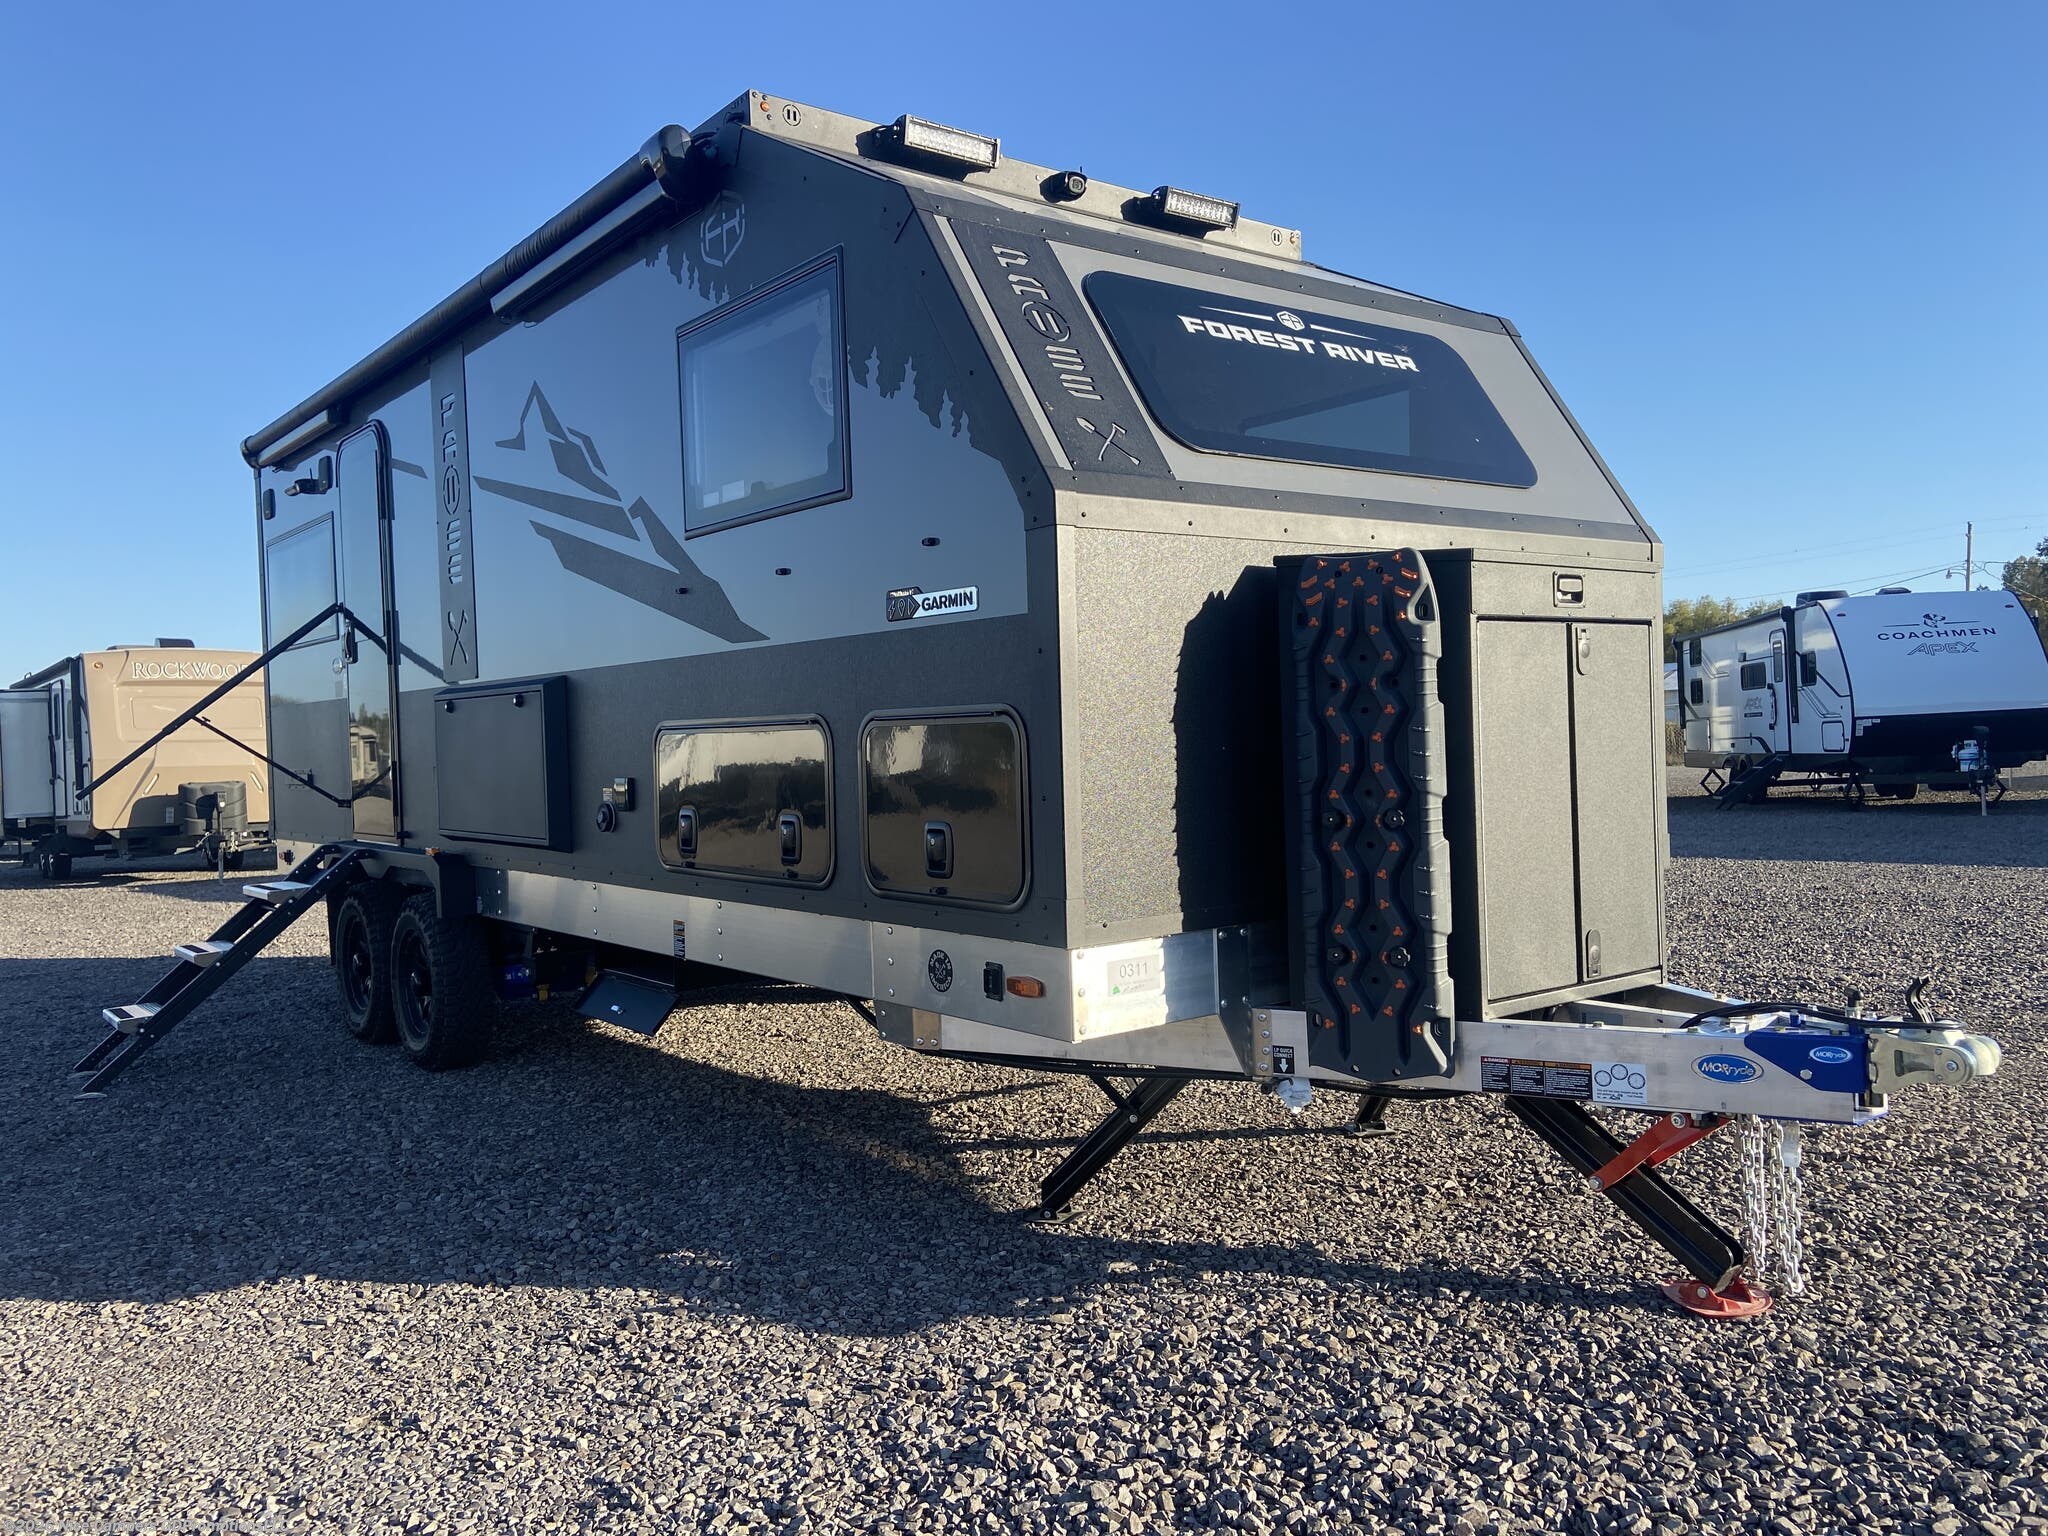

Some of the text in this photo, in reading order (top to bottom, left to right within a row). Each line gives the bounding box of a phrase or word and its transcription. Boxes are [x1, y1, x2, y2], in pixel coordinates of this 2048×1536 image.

[1177, 315, 1420, 373] FOREST RIVER
[921, 591, 973, 612] GARMIN
[1877, 627, 1997, 641] COACHMEN
[1907, 641, 1979, 656] APEX
[1119, 962, 1148, 978] 0311
